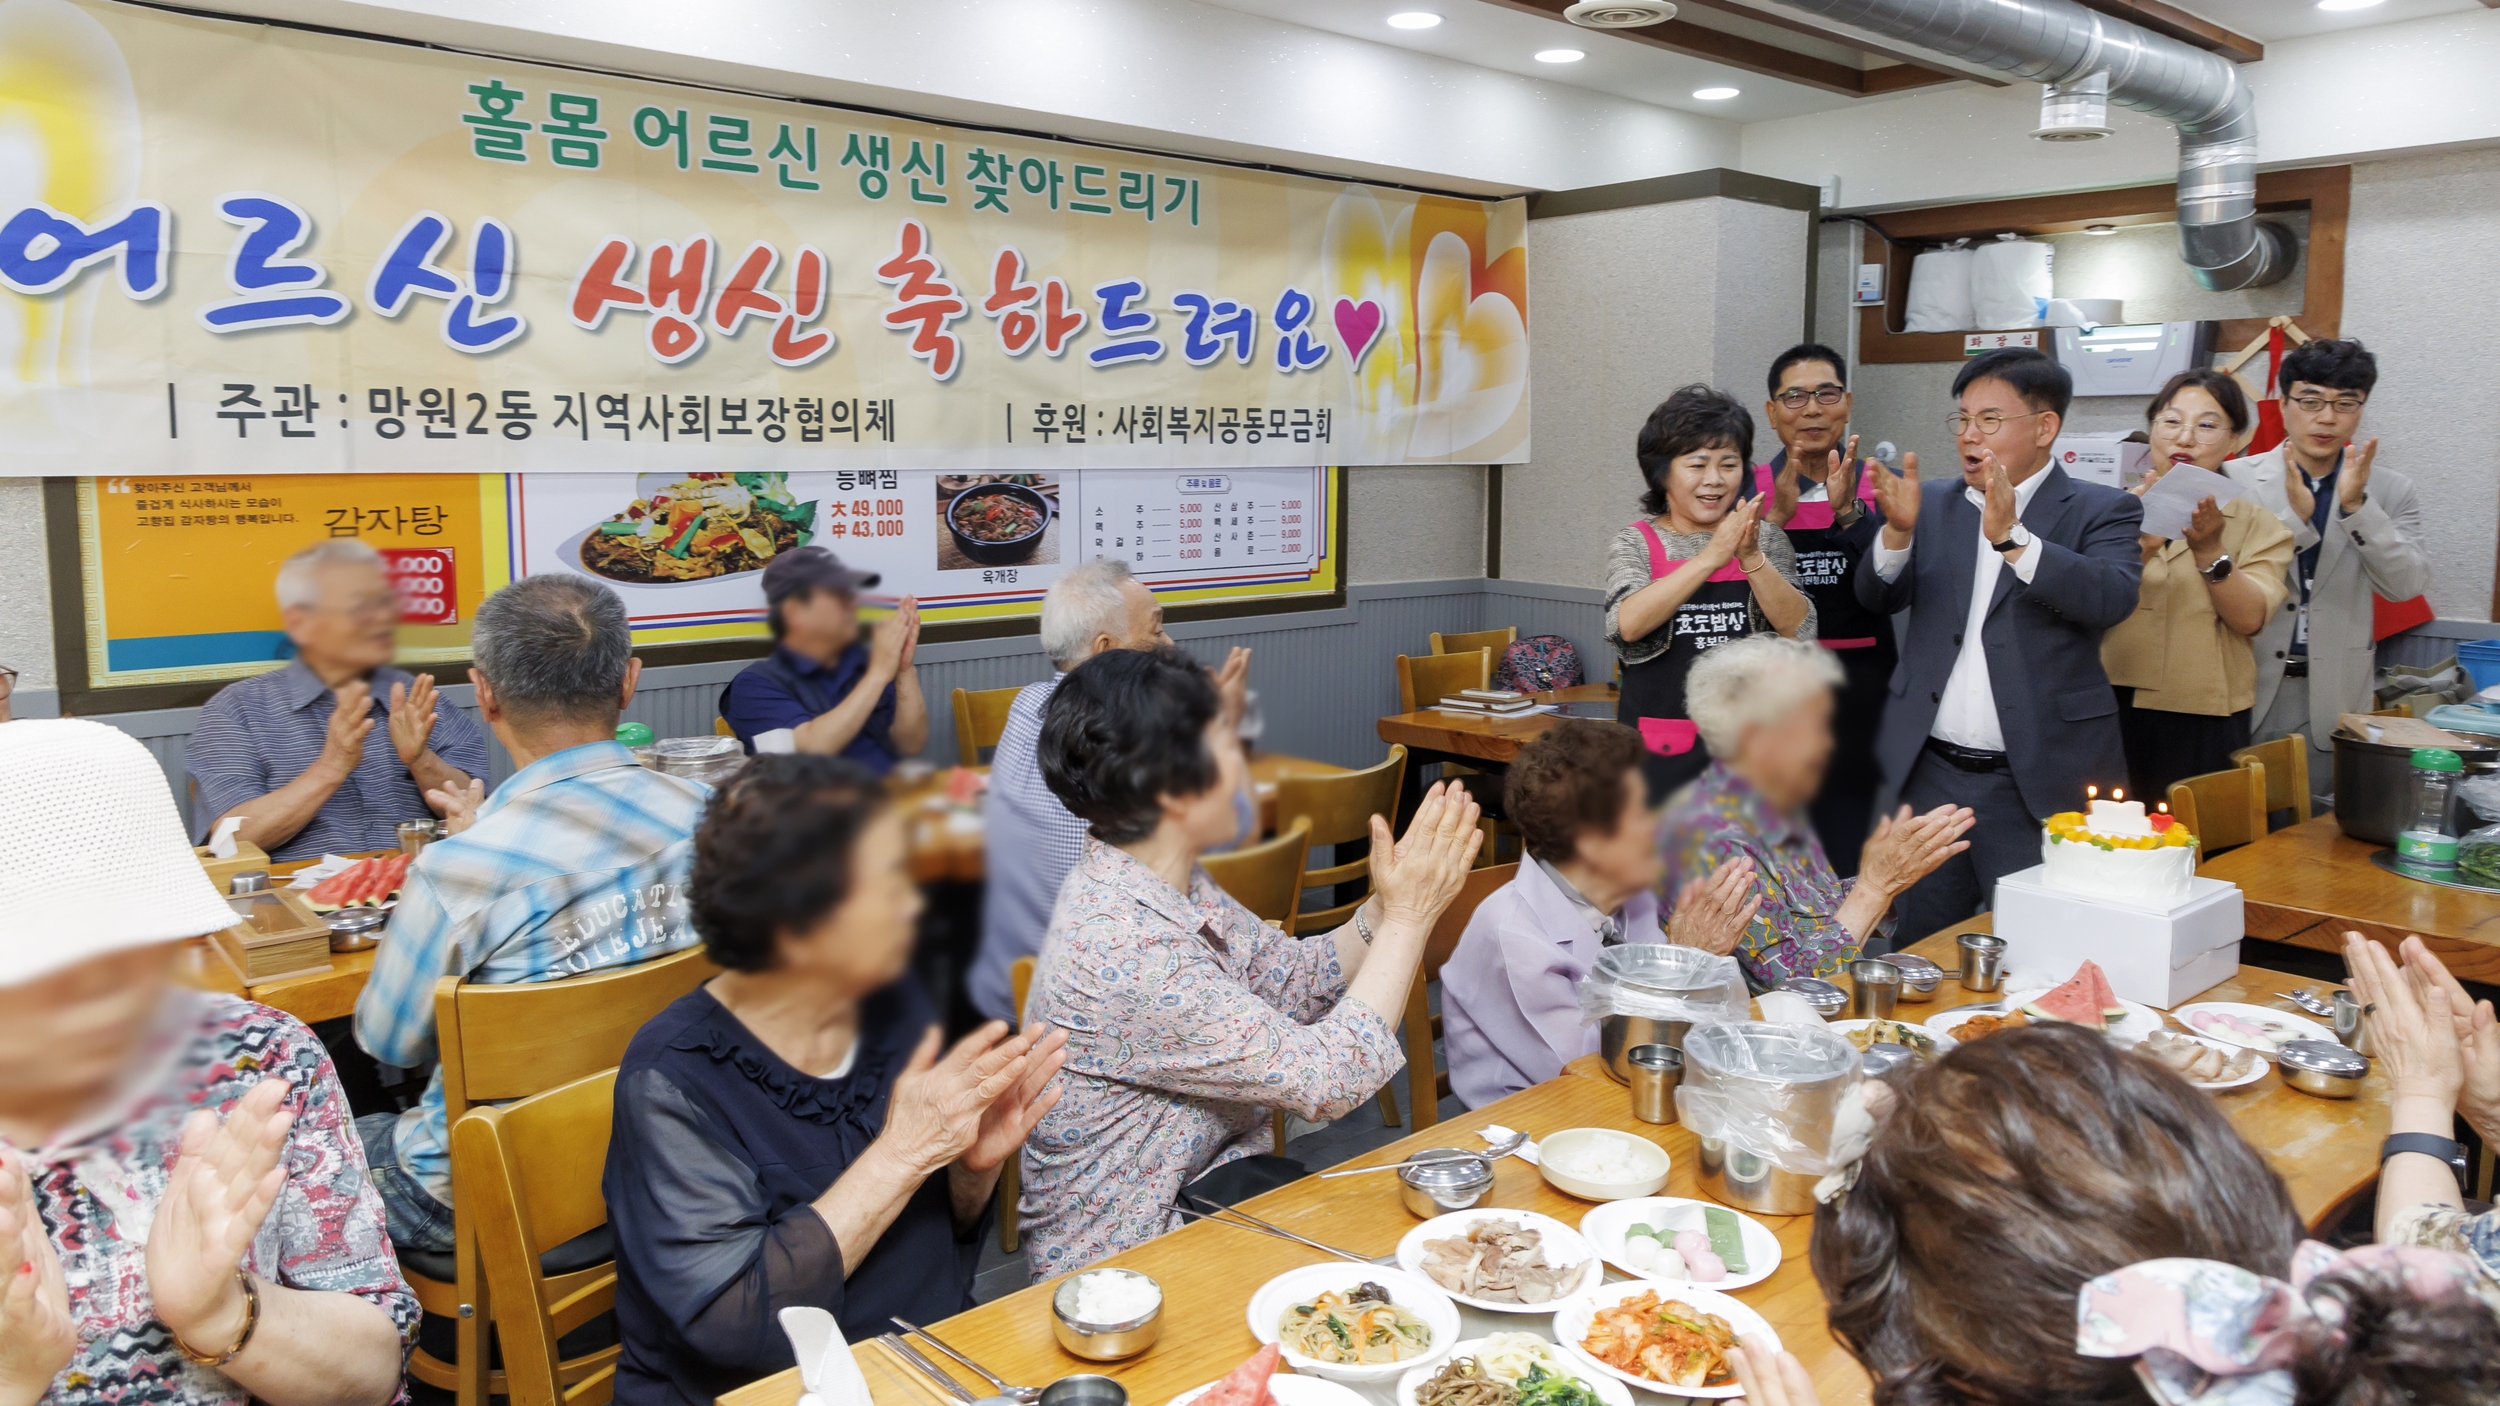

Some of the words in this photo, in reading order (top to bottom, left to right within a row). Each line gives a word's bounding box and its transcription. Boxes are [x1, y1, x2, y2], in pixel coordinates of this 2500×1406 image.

[462, 79, 607, 169] 홀몸
[633, 106, 820, 191] 어르신
[840, 132, 948, 204] 생신
[966, 147, 1199, 227] 찾아드리기
[0, 197, 519, 347] 어르신
[573, 237, 829, 362] 생신
[878, 222, 1327, 376] 축하드려요
[368, 386, 538, 441] 망원2동
[552, 391, 895, 443] 지역사회보장협의체
[1112, 404, 1332, 445] 사회복지공동모금회
[133, 481, 185, 494] 찾아주신
[189, 481, 252, 493] 고객님께서
[1186, 478, 1200, 489] 주류
[1208, 478, 1222, 489] 음료
[135, 499, 175, 511] 즐겁게
[179, 498, 242, 510] 식사하시는
[245, 497, 282, 509] 모습이
[831, 501, 848, 518] 大
[851, 498, 904, 518] 49,000
[1179, 502, 1203, 514] 5,000
[1280, 499, 1302, 510] 5,000
[136, 515, 175, 527] 고향집
[180, 514, 230, 527] 감자탕의
[234, 513, 300, 525] 행복입니다.
[323, 505, 449, 538] 감자탕
[1179, 518, 1203, 529] 5,000
[1280, 513, 1302, 525] 9,000
[831, 521, 848, 539] 中
[851, 518, 904, 538] 43,000
[1280, 528, 1302, 539] 9,000
[1179, 533, 1203, 544] 5,000
[1179, 548, 1203, 559] 6,000
[1280, 542, 1302, 554] 2,000
[982, 568, 1018, 585] 육개장
[1674, 610, 1747, 636] 효도밥상
[554, 883, 692, 953] EDUCATI
